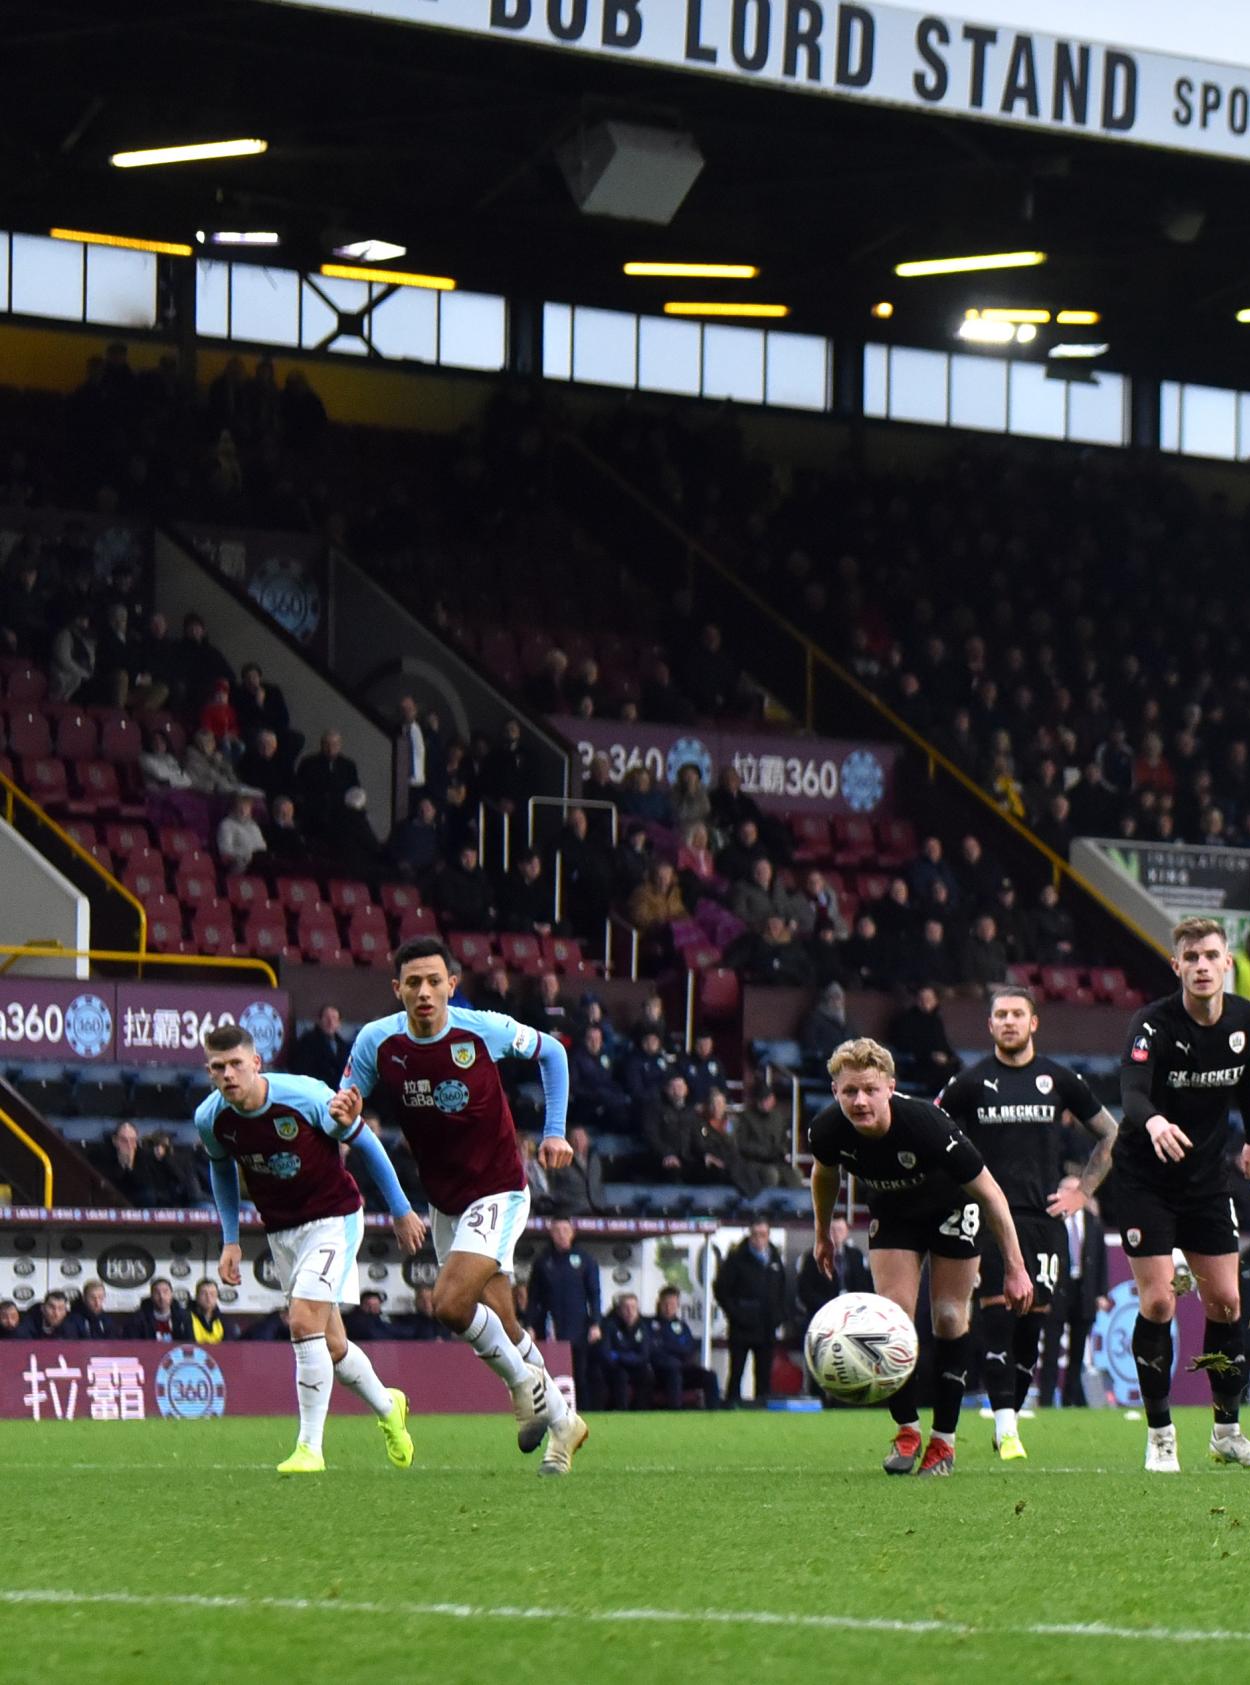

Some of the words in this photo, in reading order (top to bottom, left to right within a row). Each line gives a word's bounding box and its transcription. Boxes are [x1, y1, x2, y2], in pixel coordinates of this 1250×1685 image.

[684, 0, 876, 88] LORD
[912, 17, 1139, 131] STAND
[939, 1203, 980, 1237] 28
[319, 1248, 336, 1277] 7
[1036, 1252, 1059, 1284] 10
[831, 1342, 851, 1384] mitre
[173, 1379, 209, 1402] 360
